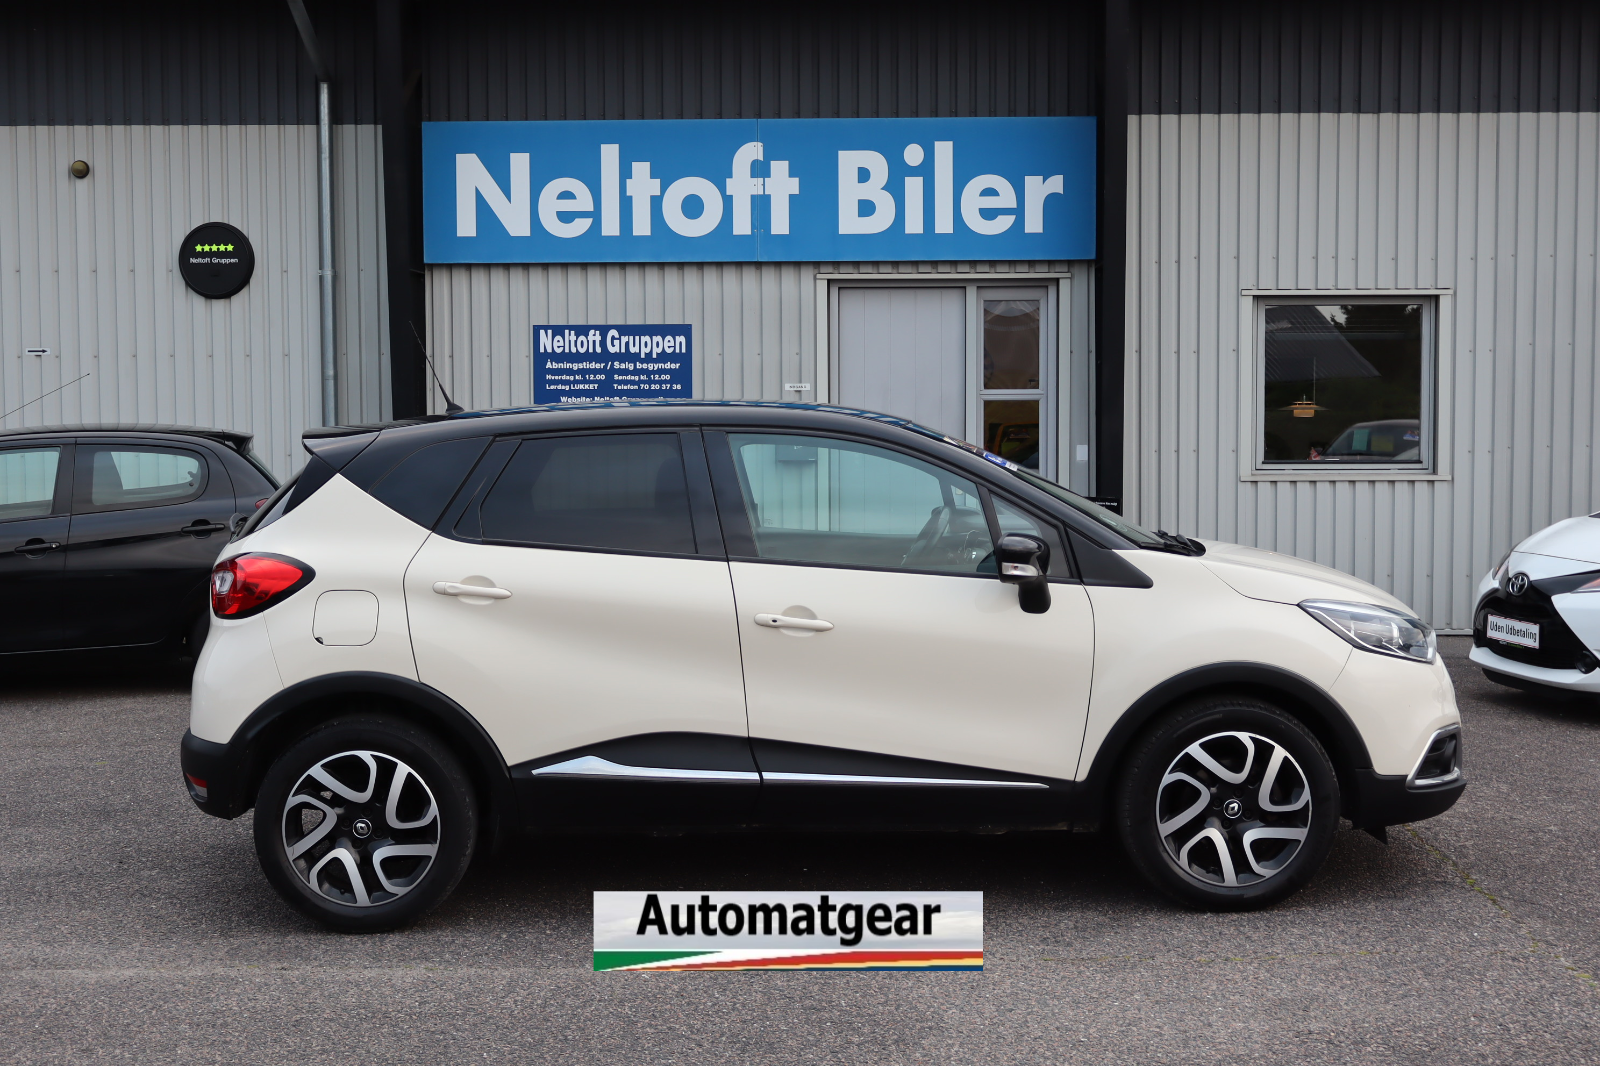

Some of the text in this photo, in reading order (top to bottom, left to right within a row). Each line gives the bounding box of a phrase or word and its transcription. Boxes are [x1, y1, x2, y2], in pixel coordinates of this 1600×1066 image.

[455, 141, 1064, 239] Neltoft Biler
[539, 328, 686, 358] Neltoft Gruppen
[545, 359, 680, 370] Åbningstider / Salg begynder
[1490, 620, 1537, 643] Uden Udbetaling
